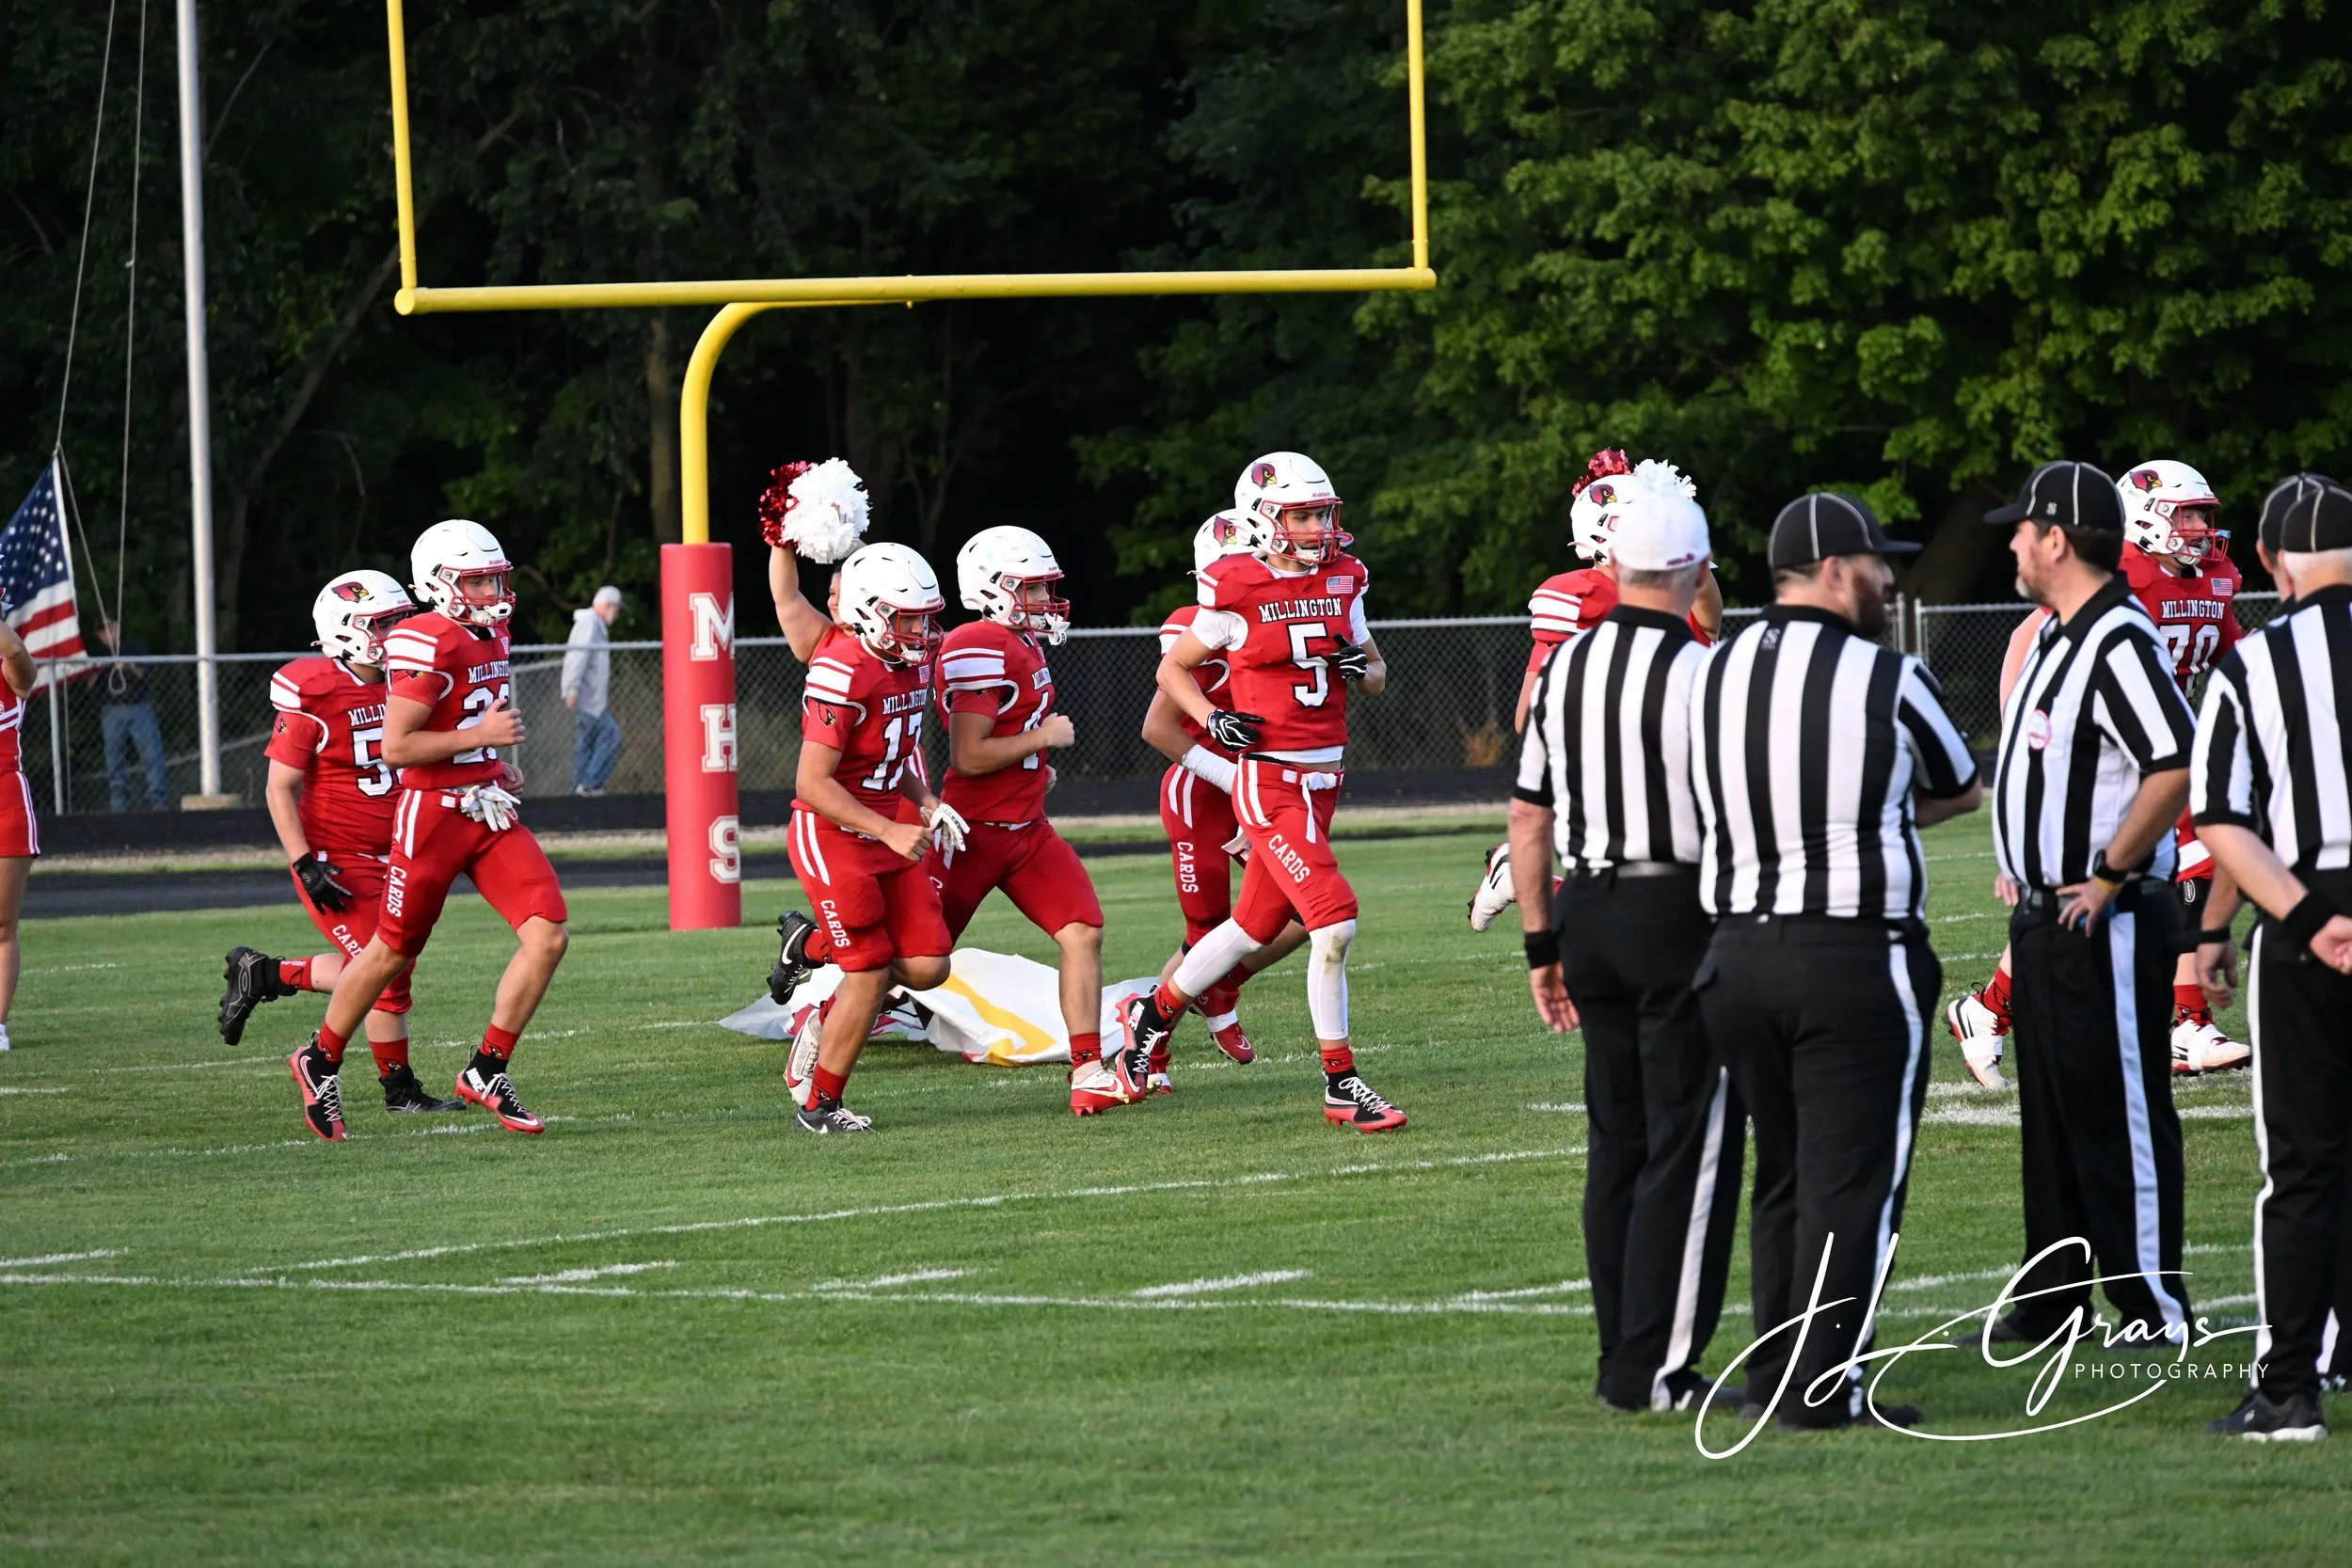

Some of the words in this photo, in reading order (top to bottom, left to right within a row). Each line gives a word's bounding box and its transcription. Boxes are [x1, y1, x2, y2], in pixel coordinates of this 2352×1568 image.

[1259, 598, 1342, 623] MILLINGTON
[2162, 600, 2225, 619] MILLINGTON
[1288, 623, 1328, 706] 5
[2160, 625, 2220, 675] 70
[862, 711, 922, 791] 17
[1177, 841, 1200, 894] CARDS
[1267, 833, 1311, 883] CARDS
[386, 865, 407, 918] CARDS
[820, 899, 851, 948] CARDS
